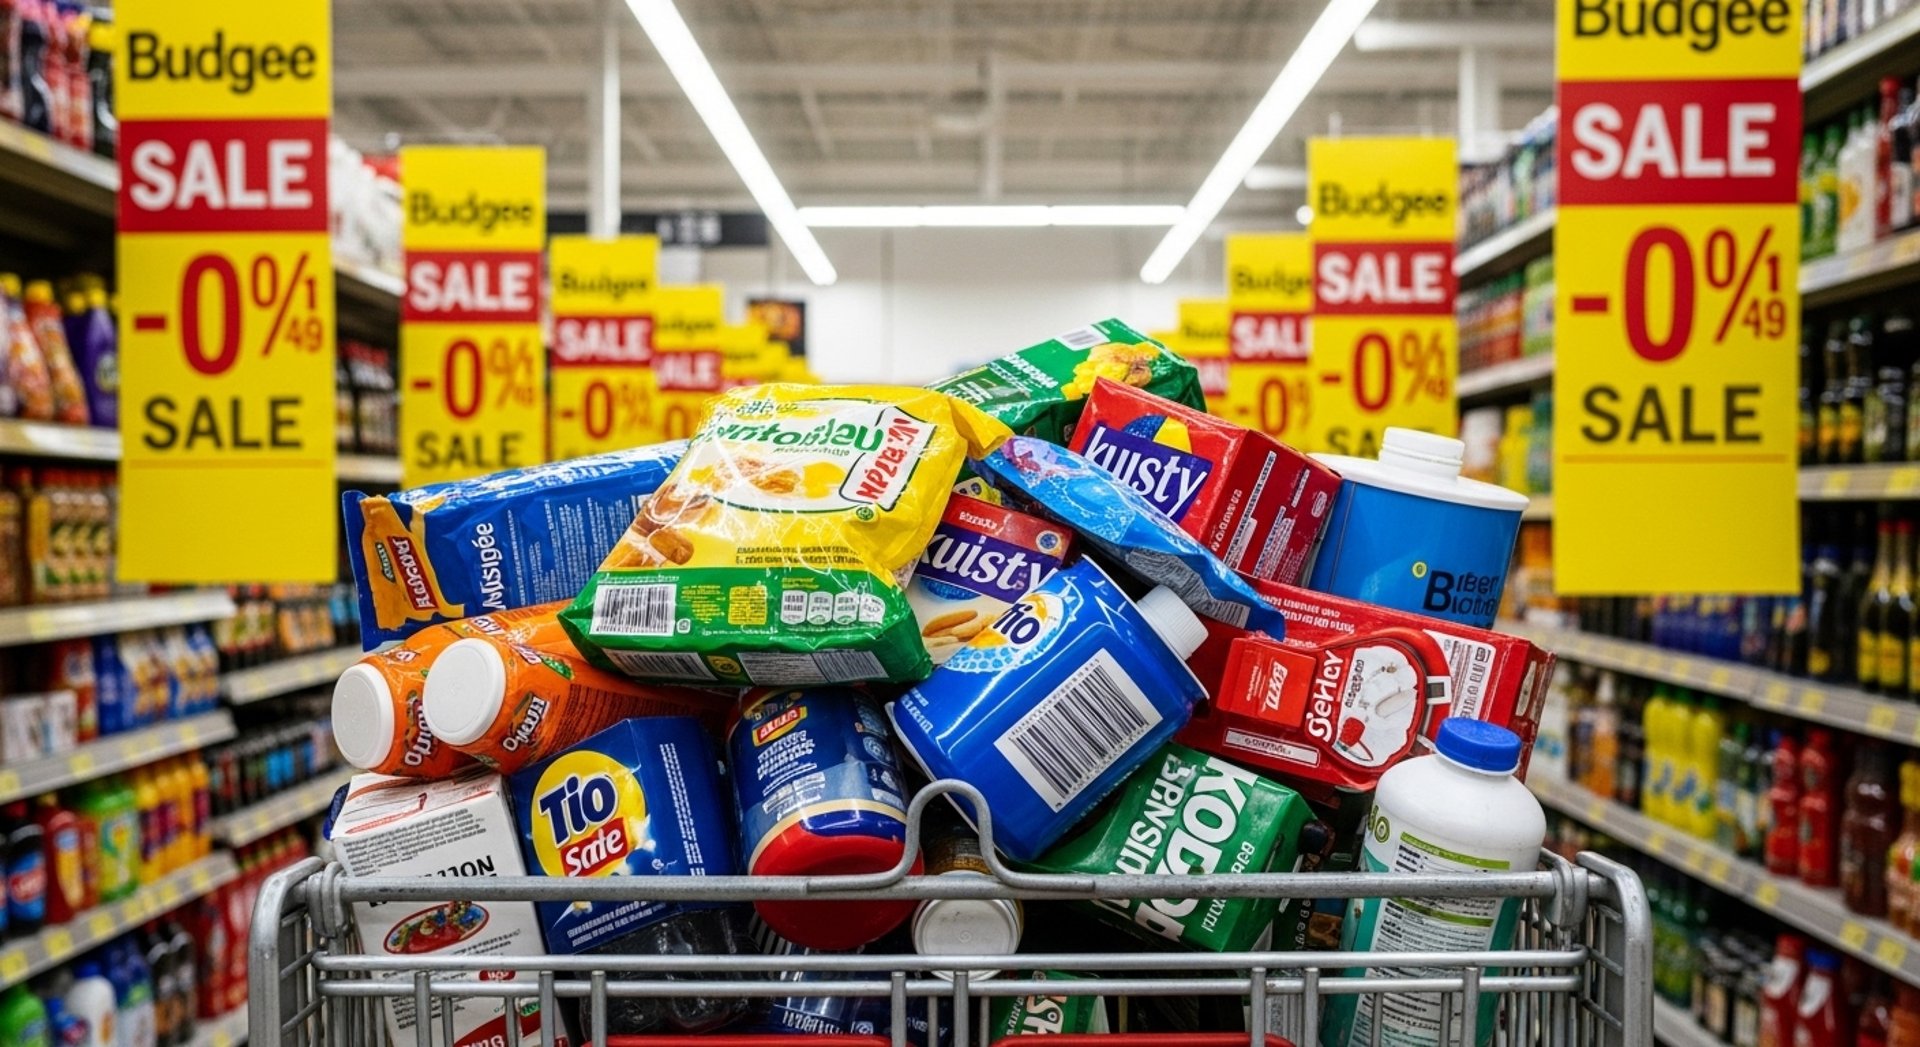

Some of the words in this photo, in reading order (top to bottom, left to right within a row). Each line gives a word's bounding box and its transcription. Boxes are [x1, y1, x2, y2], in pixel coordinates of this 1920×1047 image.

[1574, 0, 1789, 52] Budgee
[127, 31, 317, 94] Budgee
[1572, 104, 1776, 180] SALE
[130, 140, 313, 210] SALE
[409, 193, 533, 234] Budgee
[1318, 182, 1447, 226] Budgee
[409, 262, 533, 311] SALE
[1318, 252, 1446, 304] SALE
[559, 317, 650, 362] SALE
[1232, 314, 1310, 358] SAL
[142, 398, 303, 450] SALE
[1580, 384, 1763, 444] SALE
[416, 431, 523, 469] SALE
[538, 773, 619, 849] Tio
